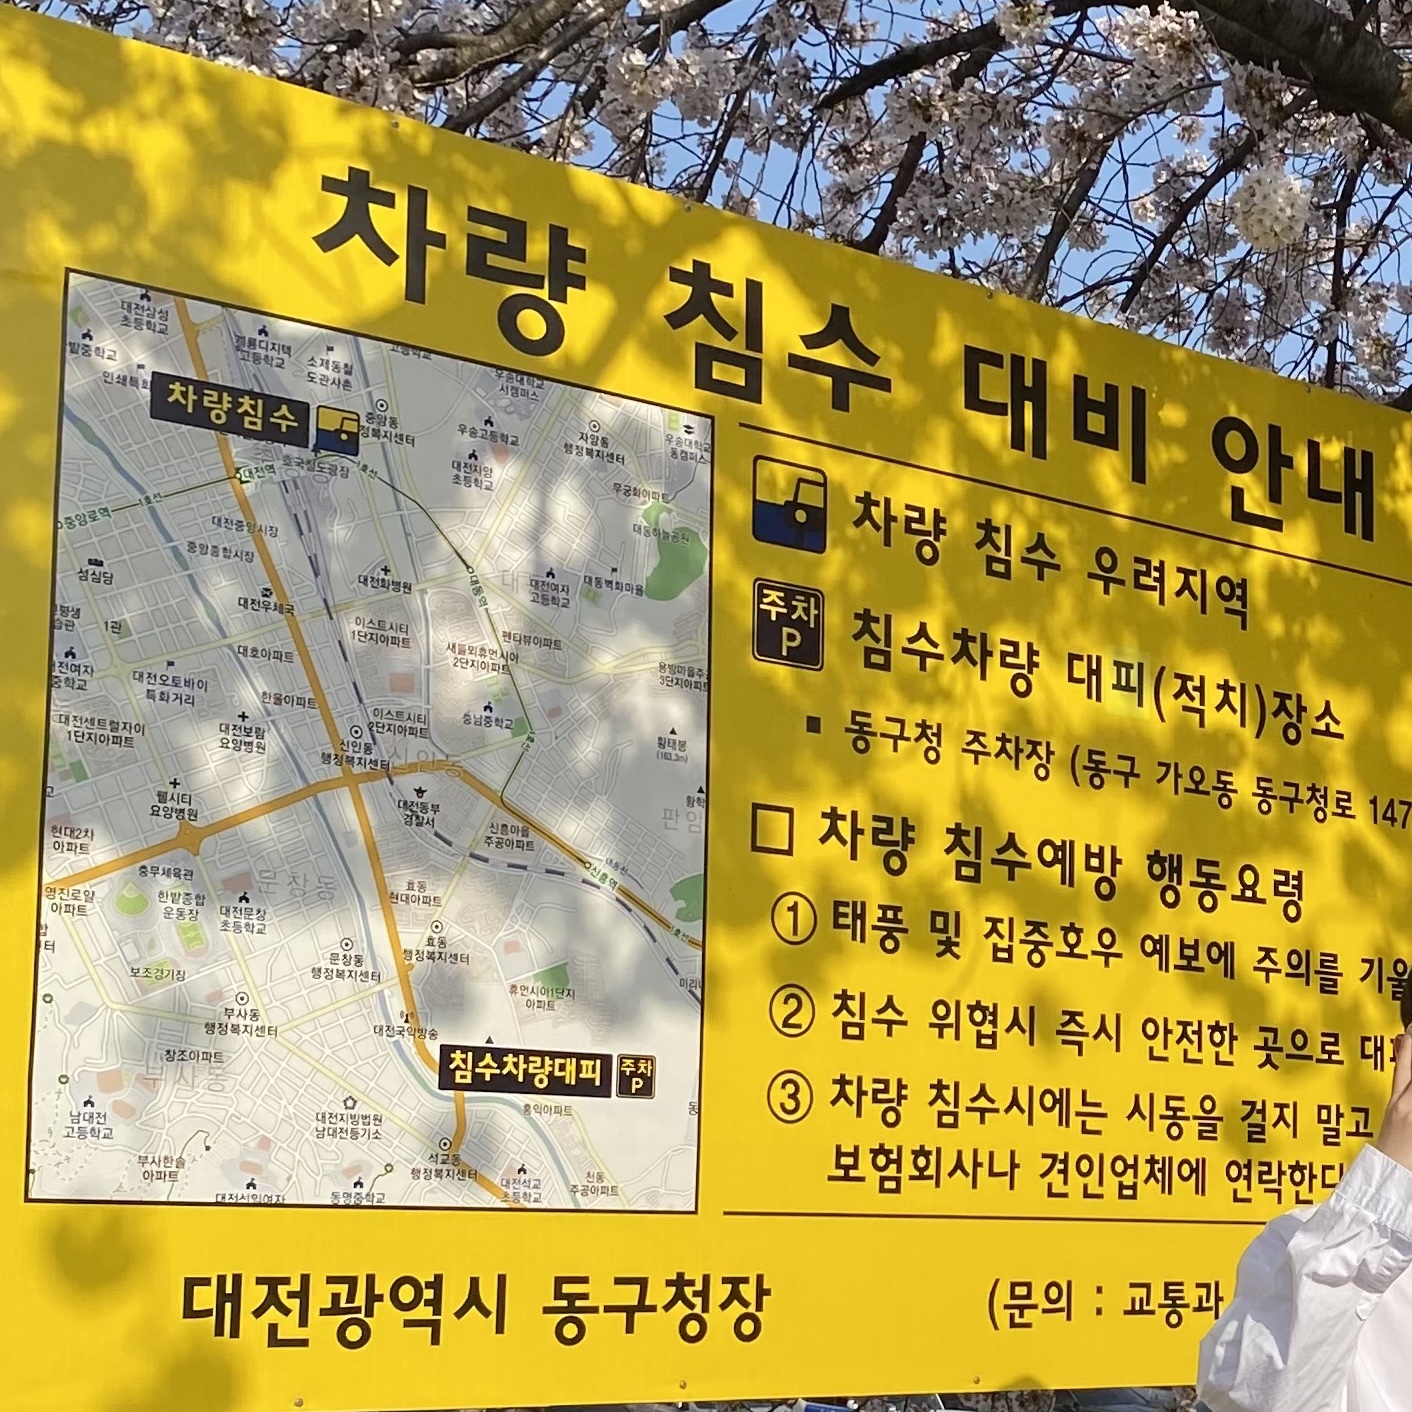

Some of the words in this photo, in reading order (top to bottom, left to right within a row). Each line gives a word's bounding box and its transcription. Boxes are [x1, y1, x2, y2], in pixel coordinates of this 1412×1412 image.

[121, 315, 169, 335] 초등학교
[240, 350, 285, 369] 고등학교
[311, 166, 586, 356] 차량
[663, 258, 891, 413] 침수
[964, 344, 1146, 485] 대비
[1212, 416, 1374, 542] 안내
[167, 381, 299, 433] 차량침수
[457, 423, 519, 447] 우송고등학교
[564, 442, 625, 465] 행정복지센터
[452, 474, 494, 492] 초등학교
[64, 507, 112, 530] 중앙로역
[853, 490, 947, 566] 차량
[974, 517, 1061, 582] 침수
[1087, 545, 1248, 631] 우려지역
[530, 591, 570, 609] 고등학교
[759, 589, 819, 628] 주차
[355, 616, 409, 636] 이스트시티
[351, 629, 411, 649] 1단지아파트
[781, 627, 801, 656] P
[453, 656, 511, 675] 2단지아파트
[132, 670, 208, 693] 대전오토바이
[852, 608, 1040, 699] 침수차량
[1067, 652, 1345, 746] 대피(적치)장소
[373, 707, 427, 726] 이스트시티
[67, 731, 135, 749] 1단지아파트
[368, 721, 430, 740] 2단지아파트
[321, 753, 390, 772] 행정복지센터
[844, 710, 942, 765] 동구청
[961, 729, 1055, 782] 주차장
[1070, 744, 1140, 790] (동구
[1156, 760, 1238, 810] 가오동
[1252, 776, 1356, 824] 동구청로
[150, 805, 198, 821] 요양병원
[53, 841, 90, 855] 아파트
[484, 836, 535, 852] 주공아파트
[818, 806, 916, 877] 차량
[943, 822, 1123, 902] 침수예방
[1146, 848, 1304, 924] 행동요령
[51, 903, 89, 917] 아파트
[163, 907, 199, 922] 운동장
[220, 921, 266, 935] 초등학교
[403, 948, 470, 965] 행정복지센터
[832, 900, 909, 955] 태풍
[929, 910, 961, 961] 및
[983, 915, 1123, 969] 집중호우
[1140, 933, 1235, 981] 예보에
[1252, 945, 1344, 996] 주의를
[130, 967, 186, 982] 보조경기장
[312, 966, 381, 984] 행정복지센터
[224, 1007, 260, 1022] 부사동
[526, 1000, 556, 1011] 아파트
[204, 1022, 278, 1038] 행정복지센터
[832, 988, 908, 1041] 침수
[928, 999, 1036, 1051] 위협시
[1055, 1009, 1122, 1057] 즉시
[1142, 1016, 1238, 1067] 안전한
[1253, 1026, 1344, 1072] 곳으로
[1360, 1035, 1396, 1072] 대
[449, 1050, 601, 1089] 침수차량대피
[620, 1058, 653, 1077] 주차
[631, 1077, 643, 1094] P
[69, 1111, 107, 1125] 남대전
[315, 1112, 383, 1127] 대전지방법원
[830, 1073, 908, 1129] 차량
[928, 1078, 1108, 1136] 침수시에는
[1125, 1092, 1224, 1142] 시동을
[1240, 1099, 1298, 1144] 걸지
[1317, 1103, 1374, 1147] 말고
[63, 1126, 114, 1140] 고등학교
[315, 1127, 382, 1141] 남대전등기소
[428, 1153, 462, 1166] 석교동
[142, 1170, 179, 1183] 아파트
[411, 1167, 478, 1183] 행정복지센터
[827, 1142, 1021, 1194] 보험회사나
[1039, 1151, 1206, 1201] 견인업체에
[501, 1192, 542, 1204] 초등학교
[570, 1185, 620, 1197] 주공아파트
[182, 1272, 507, 1350] 대전광역시
[542, 1271, 771, 1347] 동구청장
[988, 1277, 1072, 1331] (문의
[1096, 1285, 1103, 1316] :
[1123, 1280, 1224, 1329] 교통과
